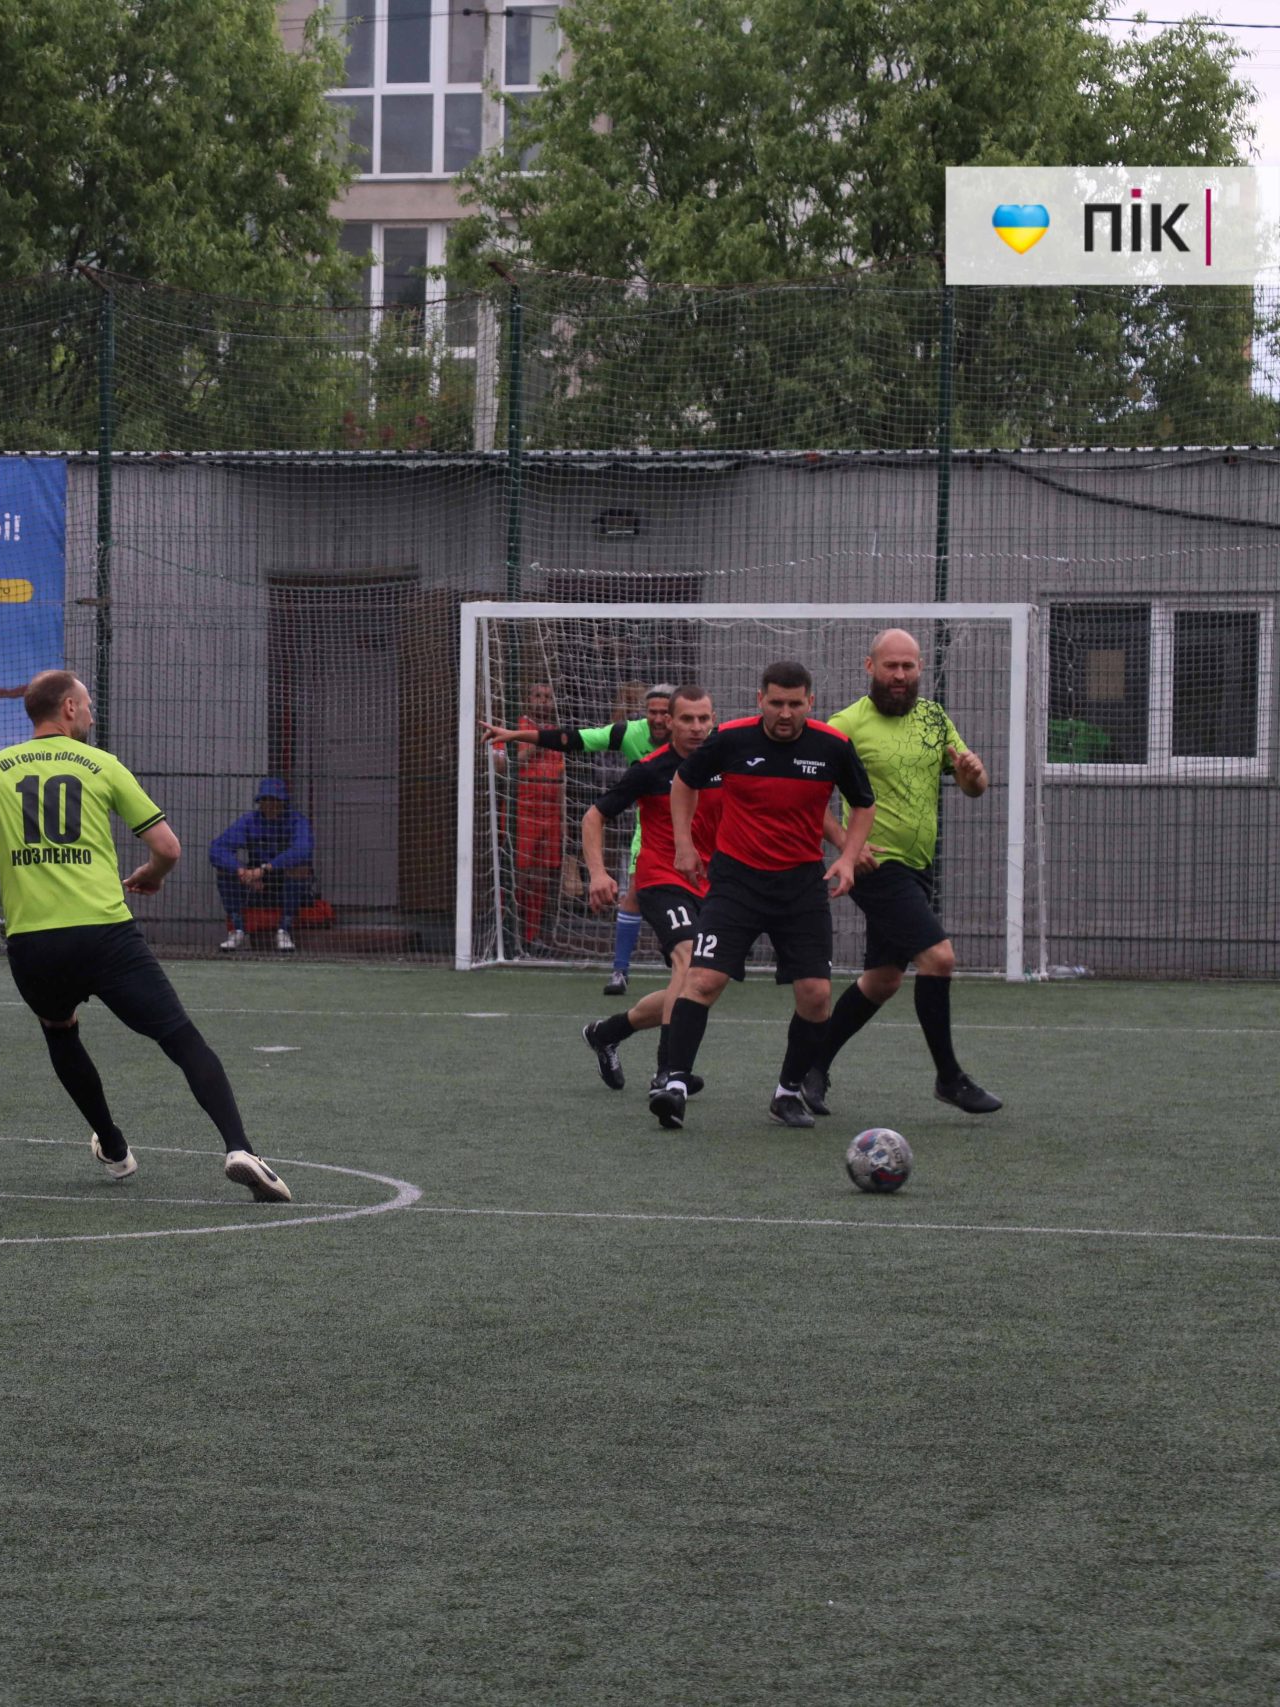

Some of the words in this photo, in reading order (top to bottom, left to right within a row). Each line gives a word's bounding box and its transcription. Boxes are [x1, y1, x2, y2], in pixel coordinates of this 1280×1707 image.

[54, 751, 103, 775] космосу
[802, 765, 818, 774] ТЕС
[15, 774, 83, 845] 10
[11, 848, 92, 866] КОЗЛЕНКО
[666, 905, 692, 930] 11
[693, 932, 718, 958] 12
